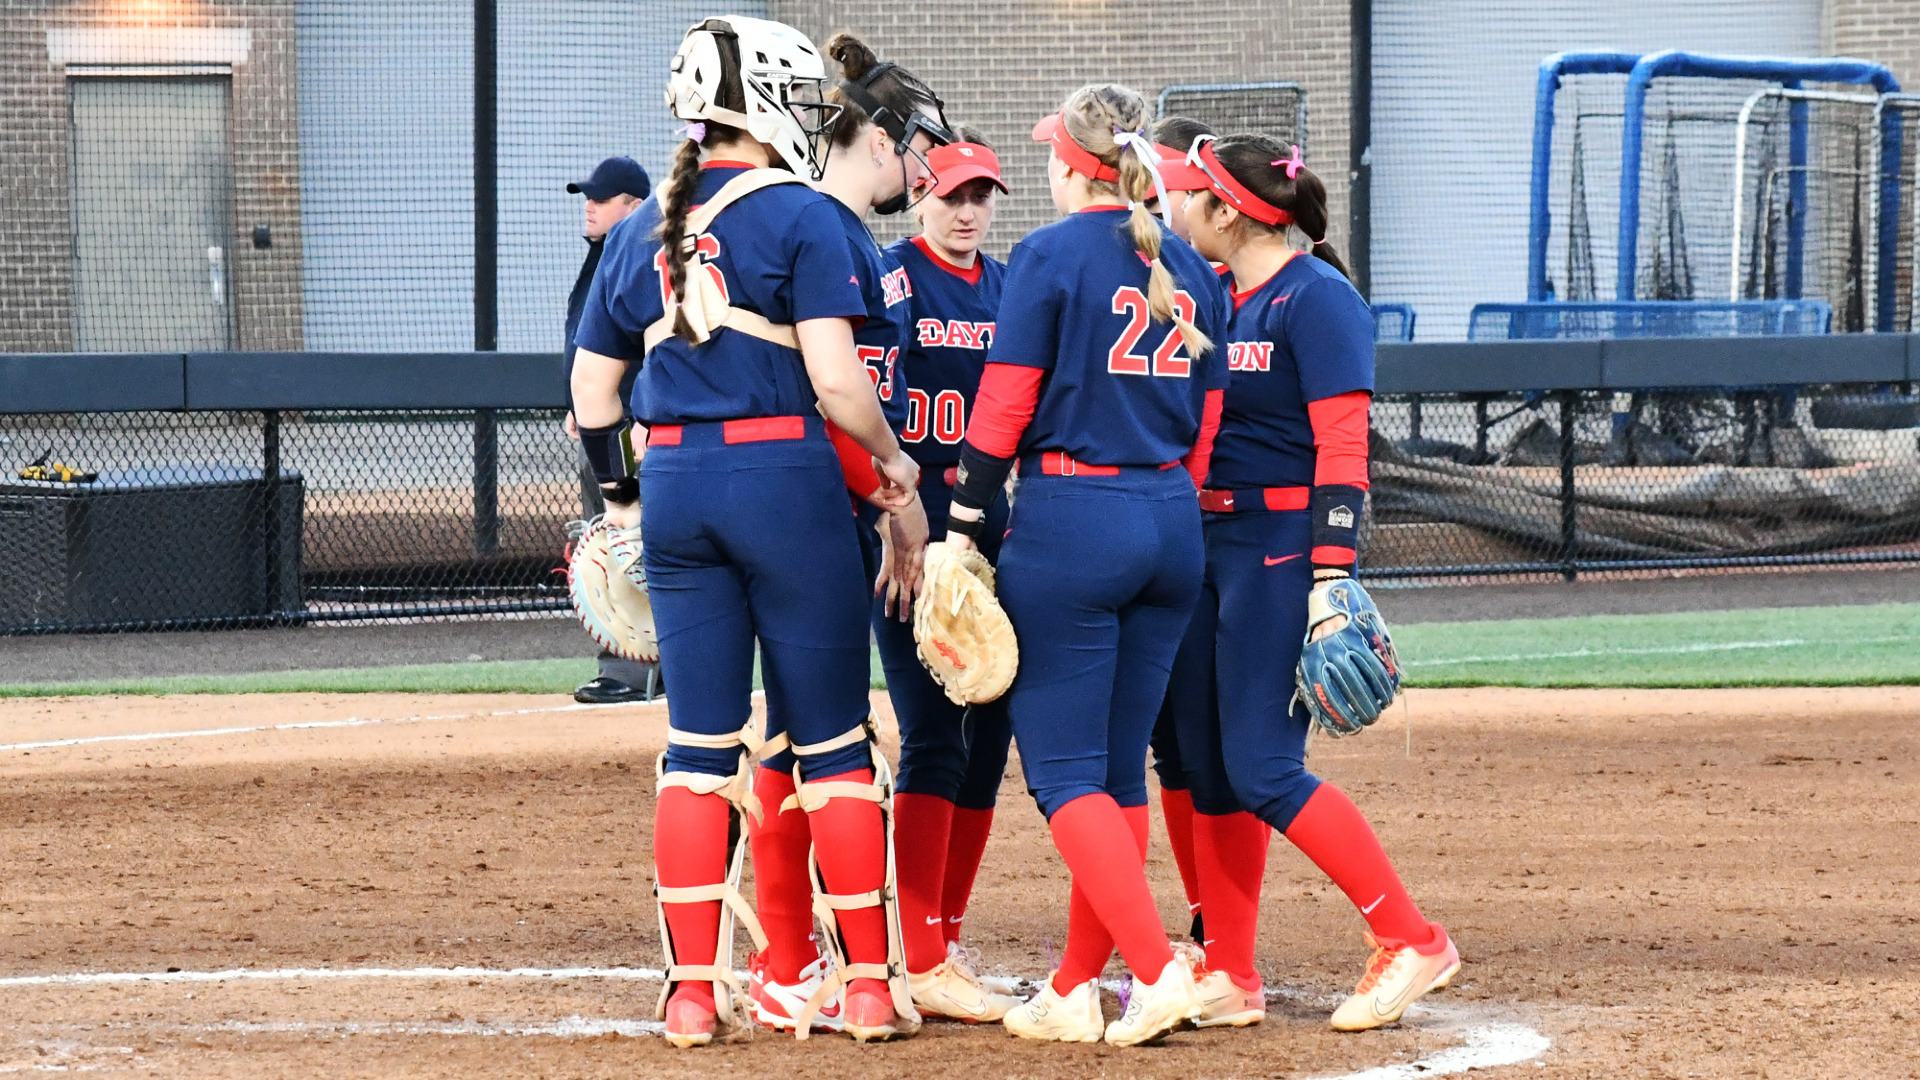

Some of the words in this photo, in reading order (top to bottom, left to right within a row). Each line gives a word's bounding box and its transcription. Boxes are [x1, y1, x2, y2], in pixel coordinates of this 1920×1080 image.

[1108, 286, 1197, 378] 22
[1227, 341, 1274, 372] ON
[856, 344, 899, 402] 53
[900, 388, 964, 445] 00
